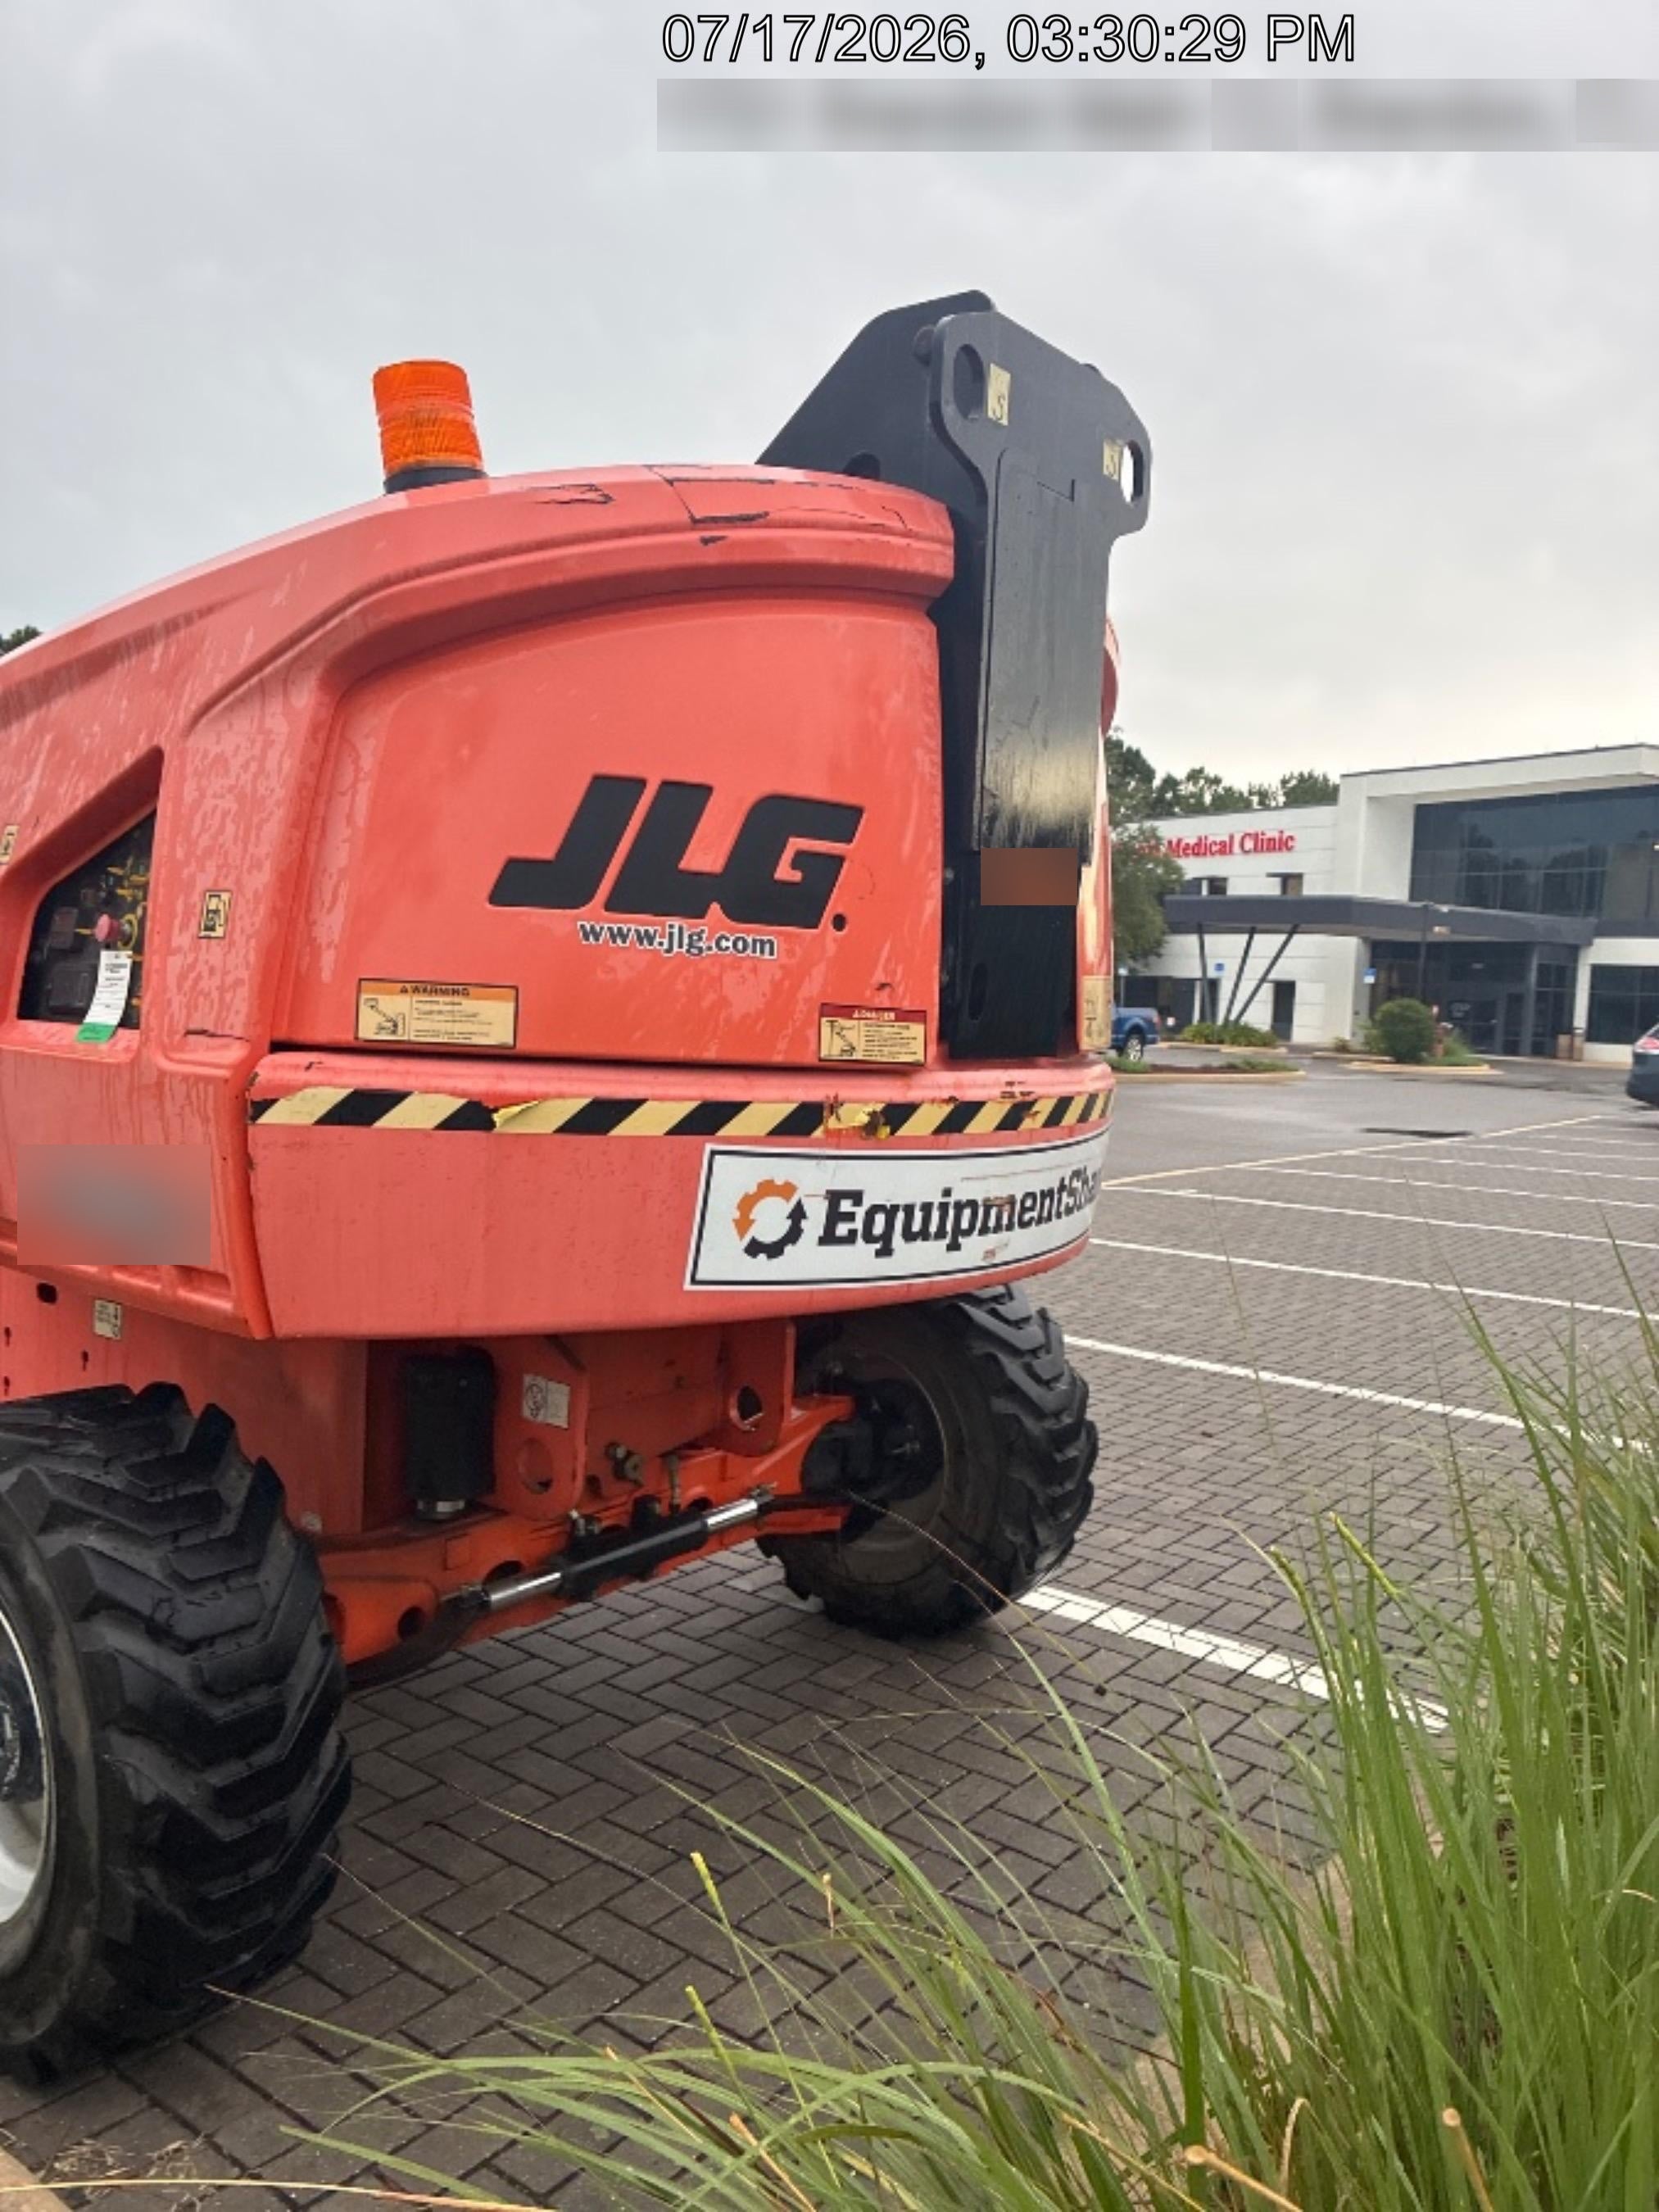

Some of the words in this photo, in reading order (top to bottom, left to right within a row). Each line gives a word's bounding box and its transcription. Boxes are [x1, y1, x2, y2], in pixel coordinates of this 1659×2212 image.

[488, 773, 865, 930] JLG
[1167, 832, 1235, 858] Medical
[1240, 829, 1296, 854] Clinic
[578, 921, 777, 958] www.jlg.com
